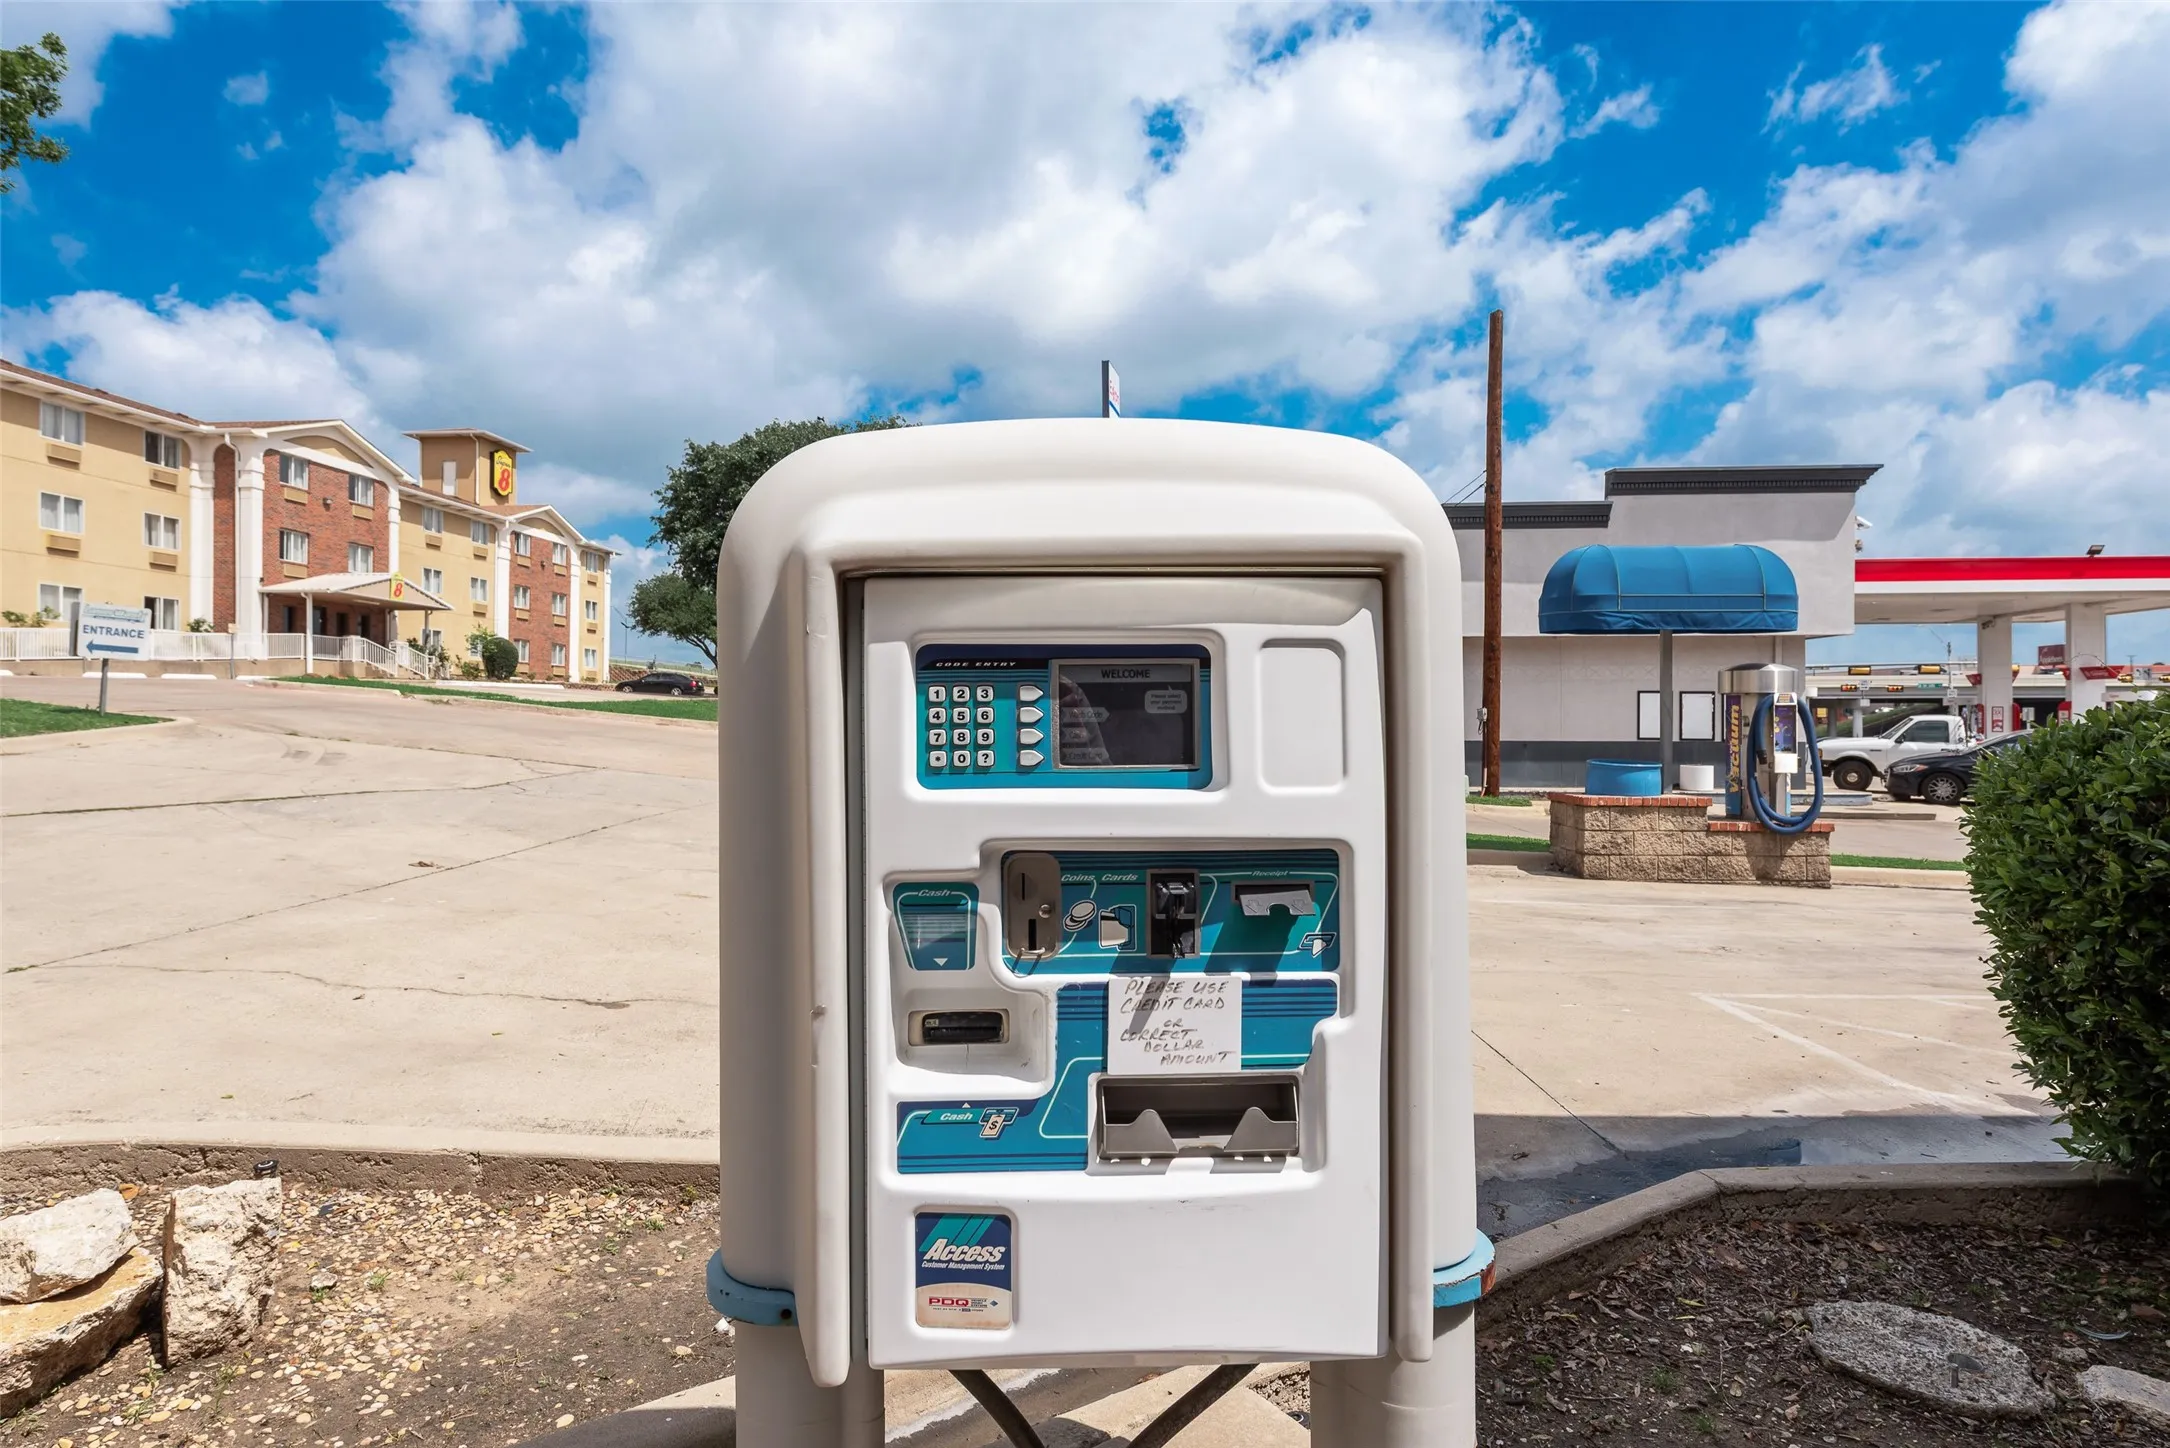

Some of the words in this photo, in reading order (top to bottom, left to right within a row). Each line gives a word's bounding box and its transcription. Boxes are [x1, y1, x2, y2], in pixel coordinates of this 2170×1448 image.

[498, 469, 511, 491] 8
[394, 582, 403, 597] 8
[83, 624, 144, 639] ENTRANCE
[1101, 669, 1151, 678] WELCOME
[933, 689, 940, 699] 1
[957, 689, 965, 699] 2
[980, 689, 989, 699] 3
[932, 711, 941, 720] 4
[957, 711, 965, 721] 5
[980, 711, 989, 720] 6
[933, 733, 941, 742] 7
[957, 732, 966, 742] 8
[981, 732, 990, 742] 9
[957, 754, 966, 763] 0
[982, 753, 989, 763] ?
[918, 889, 951, 897] Cash
[1125, 980, 1185, 995] PLEASE
[1193, 981, 1229, 994] USE
[1121, 996, 1182, 1013] CREDIT
[1183, 997, 1225, 1010] CARD
[1164, 1018, 1183, 1028] OR
[1120, 1026, 1197, 1042] CORRECT
[1144, 1039, 1204, 1052] DOLLAR
[1160, 1051, 1236, 1065] AMOUNT
[940, 1113, 973, 1121] Cash
[988, 1120, 999, 1130] $
[923, 1239, 1007, 1262] Access
[948, 1262, 984, 1271] Management
[984, 1263, 1005, 1271] System
[929, 1298, 969, 1307] PDQ
